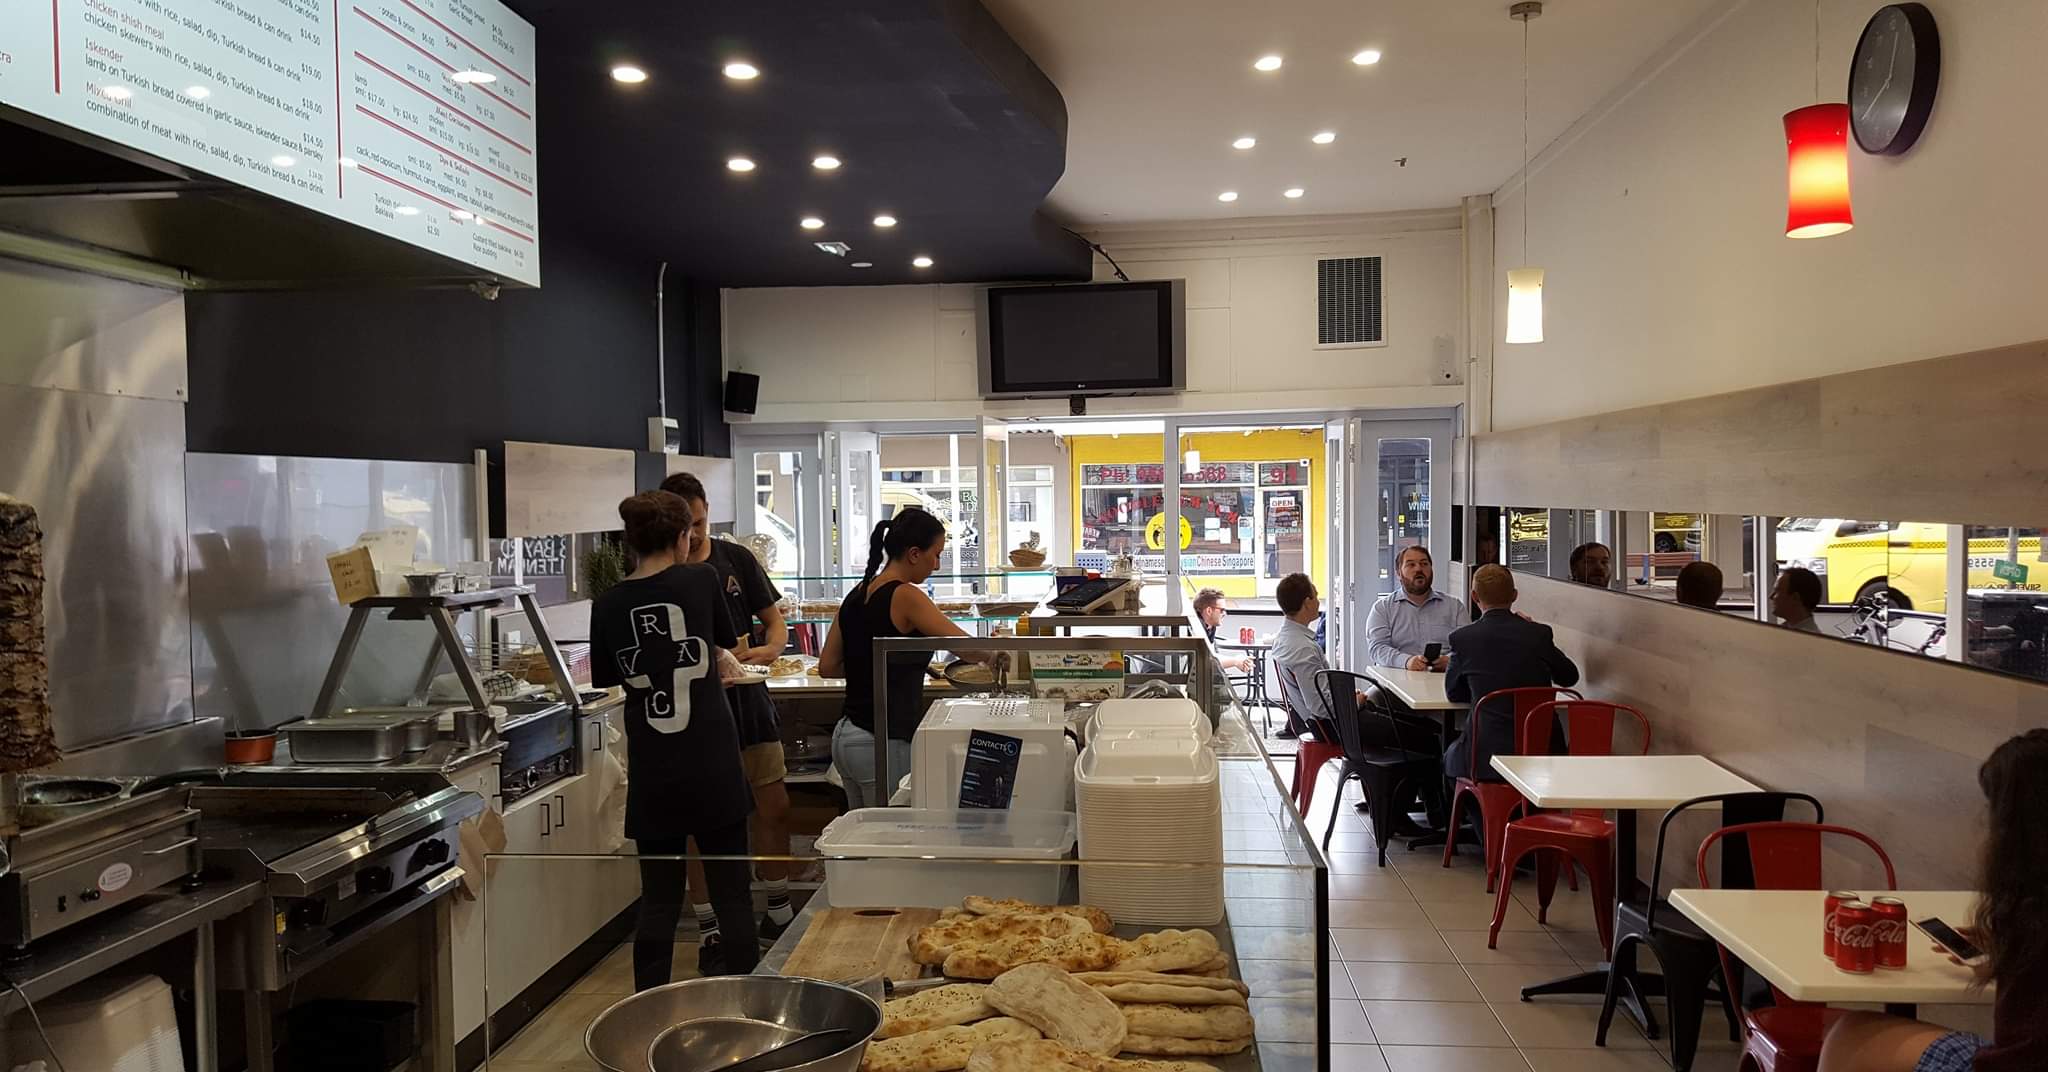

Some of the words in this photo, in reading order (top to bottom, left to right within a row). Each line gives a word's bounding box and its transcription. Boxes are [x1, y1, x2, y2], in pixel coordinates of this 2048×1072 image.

[84, 0, 118, 19] Chicken
[121, 12, 142, 30] shish
[145, 24, 164, 40] meal
[237, 7, 256, 24] bread
[264, 22, 275, 34] can
[85, 37, 123, 62] Iskender
[145, 0, 161, 14] with
[164, 7, 180, 24] rice,
[183, 17, 204, 36] salad,
[206, 28, 220, 44] dip,
[221, 34, 245, 55] Turkish
[247, 48, 266, 65] bread
[274, 63, 285, 74] can
[286, 68, 301, 82] drink
[300, 28, 320, 46] $14.50
[84, 11, 117, 34] chicken
[120, 27, 153, 51] skewers
[155, 43, 172, 59] with
[175, 53, 190, 69] rice,
[193, 61, 214, 79] salad,
[216, 71, 229, 86] dip,
[230, 77, 255, 96] Turkish
[257, 89, 275, 105] bread
[283, 102, 293, 114] can
[295, 107, 310, 121] drink
[301, 63, 321, 80] $19.00
[355, 71, 368, 87] lamb
[85, 53, 106, 72] lamb
[109, 65, 119, 77] on
[121, 68, 150, 89] Turkish
[152, 80, 174, 100] bread
[176, 93, 204, 112] covered
[206, 105, 213, 116] in
[214, 109, 232, 124] garlic
[234, 117, 254, 134] sauce,
[281, 136, 299, 150] sauce
[304, 146, 324, 161] parsley
[302, 97, 322, 114] $18.00
[86, 100, 139, 127] combination
[141, 120, 149, 130] of
[151, 123, 171, 140] meat
[174, 132, 190, 146] with
[192, 139, 208, 154] rice,
[211, 144, 231, 162] salad,
[233, 154, 246, 168] dip,
[247, 158, 271, 176] Turkish
[272, 169, 290, 183] bread
[297, 179, 307, 189] can
[309, 182, 324, 195] drink
[303, 133, 324, 148] $14.50
[1272, 499, 1293, 507] OPEN
[1222, 555, 1254, 569] Singapore
[640, 614, 668, 635] R
[620, 649, 642, 675] V
[677, 641, 698, 662] A
[651, 690, 670, 715] C
